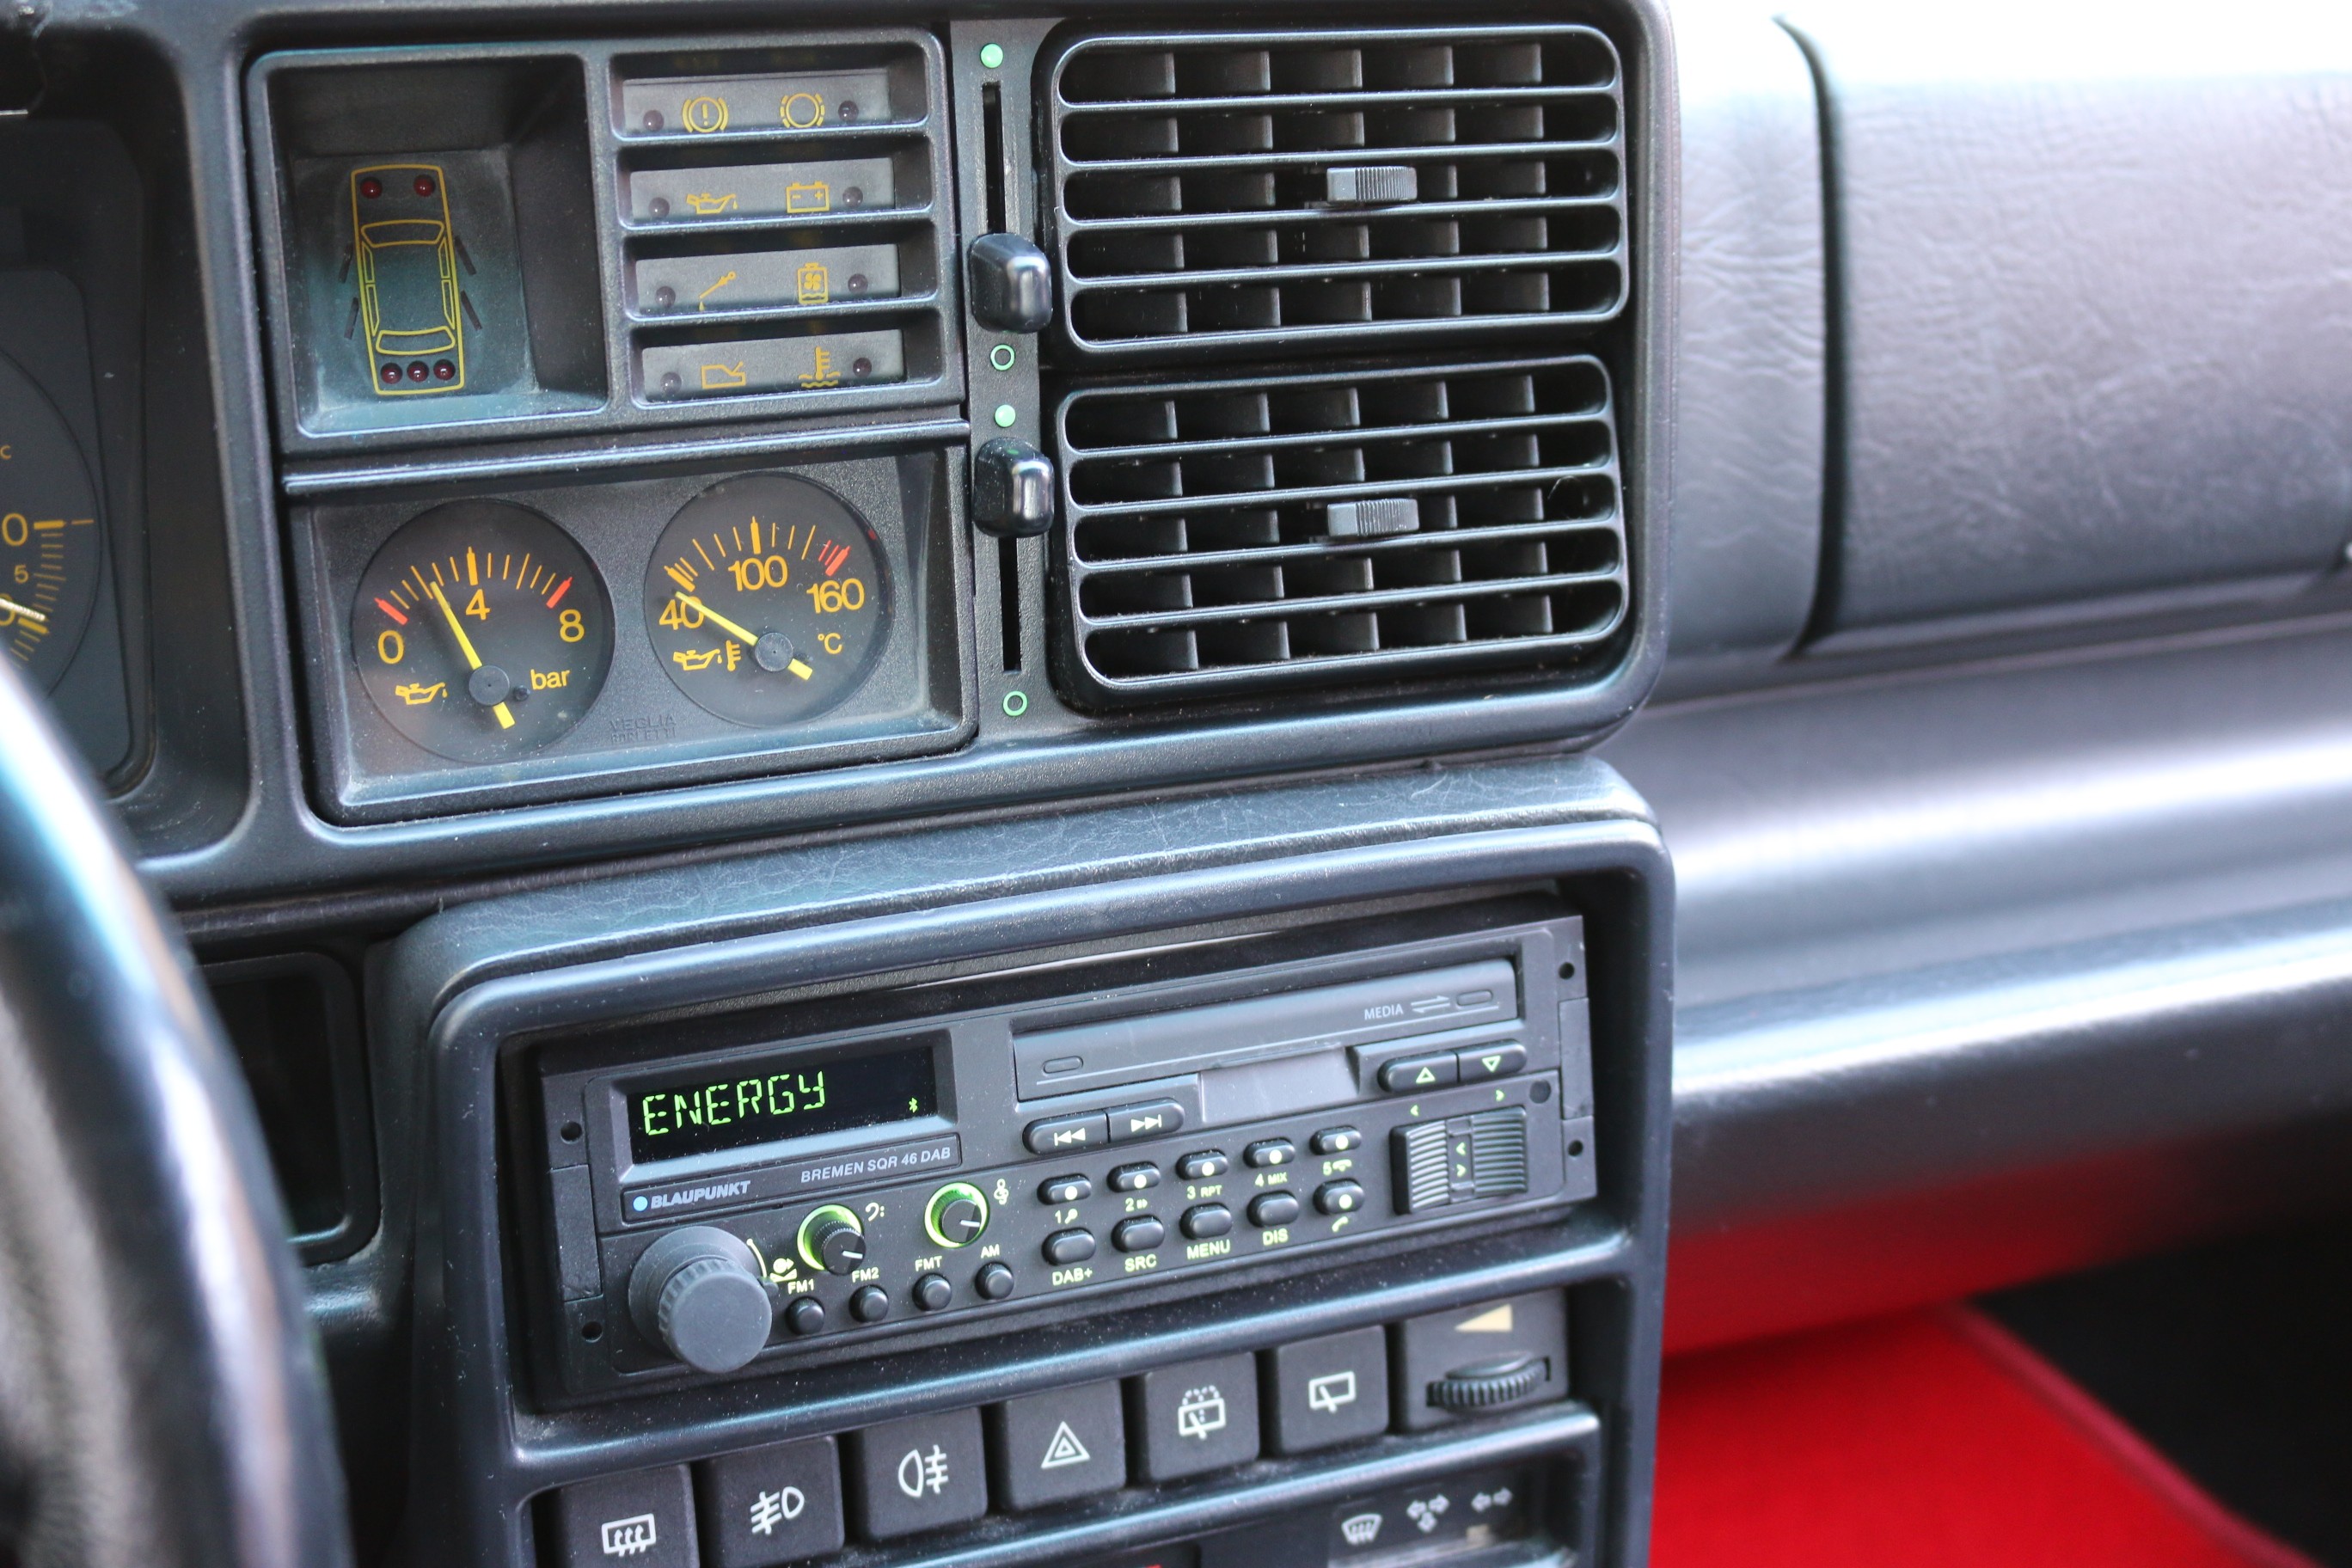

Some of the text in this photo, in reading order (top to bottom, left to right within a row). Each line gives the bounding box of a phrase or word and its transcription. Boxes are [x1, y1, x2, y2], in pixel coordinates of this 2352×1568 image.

[2, 513, 28, 546] 0
[14, 565, 29, 584] 5
[732, 555, 788, 591] 100
[466, 589, 490, 622] 4
[805, 579, 865, 614] 160
[658, 597, 705, 631] 40
[560, 609, 585, 643] 8
[377, 629, 404, 665] 0
[531, 668, 570, 690] bar
[1363, 1003, 1404, 1021] MEDIA
[641, 1070, 826, 1136] ENERGY
[800, 1161, 864, 1184] BREMEN
[901, 1151, 918, 1165] 46
[920, 1146, 951, 1163] DAB
[1322, 1161, 1332, 1176] 5
[1255, 1171, 1288, 1187] 4 MIX
[651, 1179, 750, 1210] BLAUPUNKT
[1186, 1184, 1223, 1200] 3 RPT
[1124, 1197, 1135, 1212] 2
[1054, 1210, 1063, 1224] 1
[1262, 1228, 1289, 1246] DIS
[980, 1244, 1001, 1259] AM
[1186, 1239, 1231, 1260] MENU
[915, 1255, 943, 1272] FMT
[1124, 1253, 1158, 1272] SRC
[851, 1266, 879, 1283] FM2
[1052, 1266, 1093, 1287] DAB+
[787, 1280, 815, 1295] FM1
